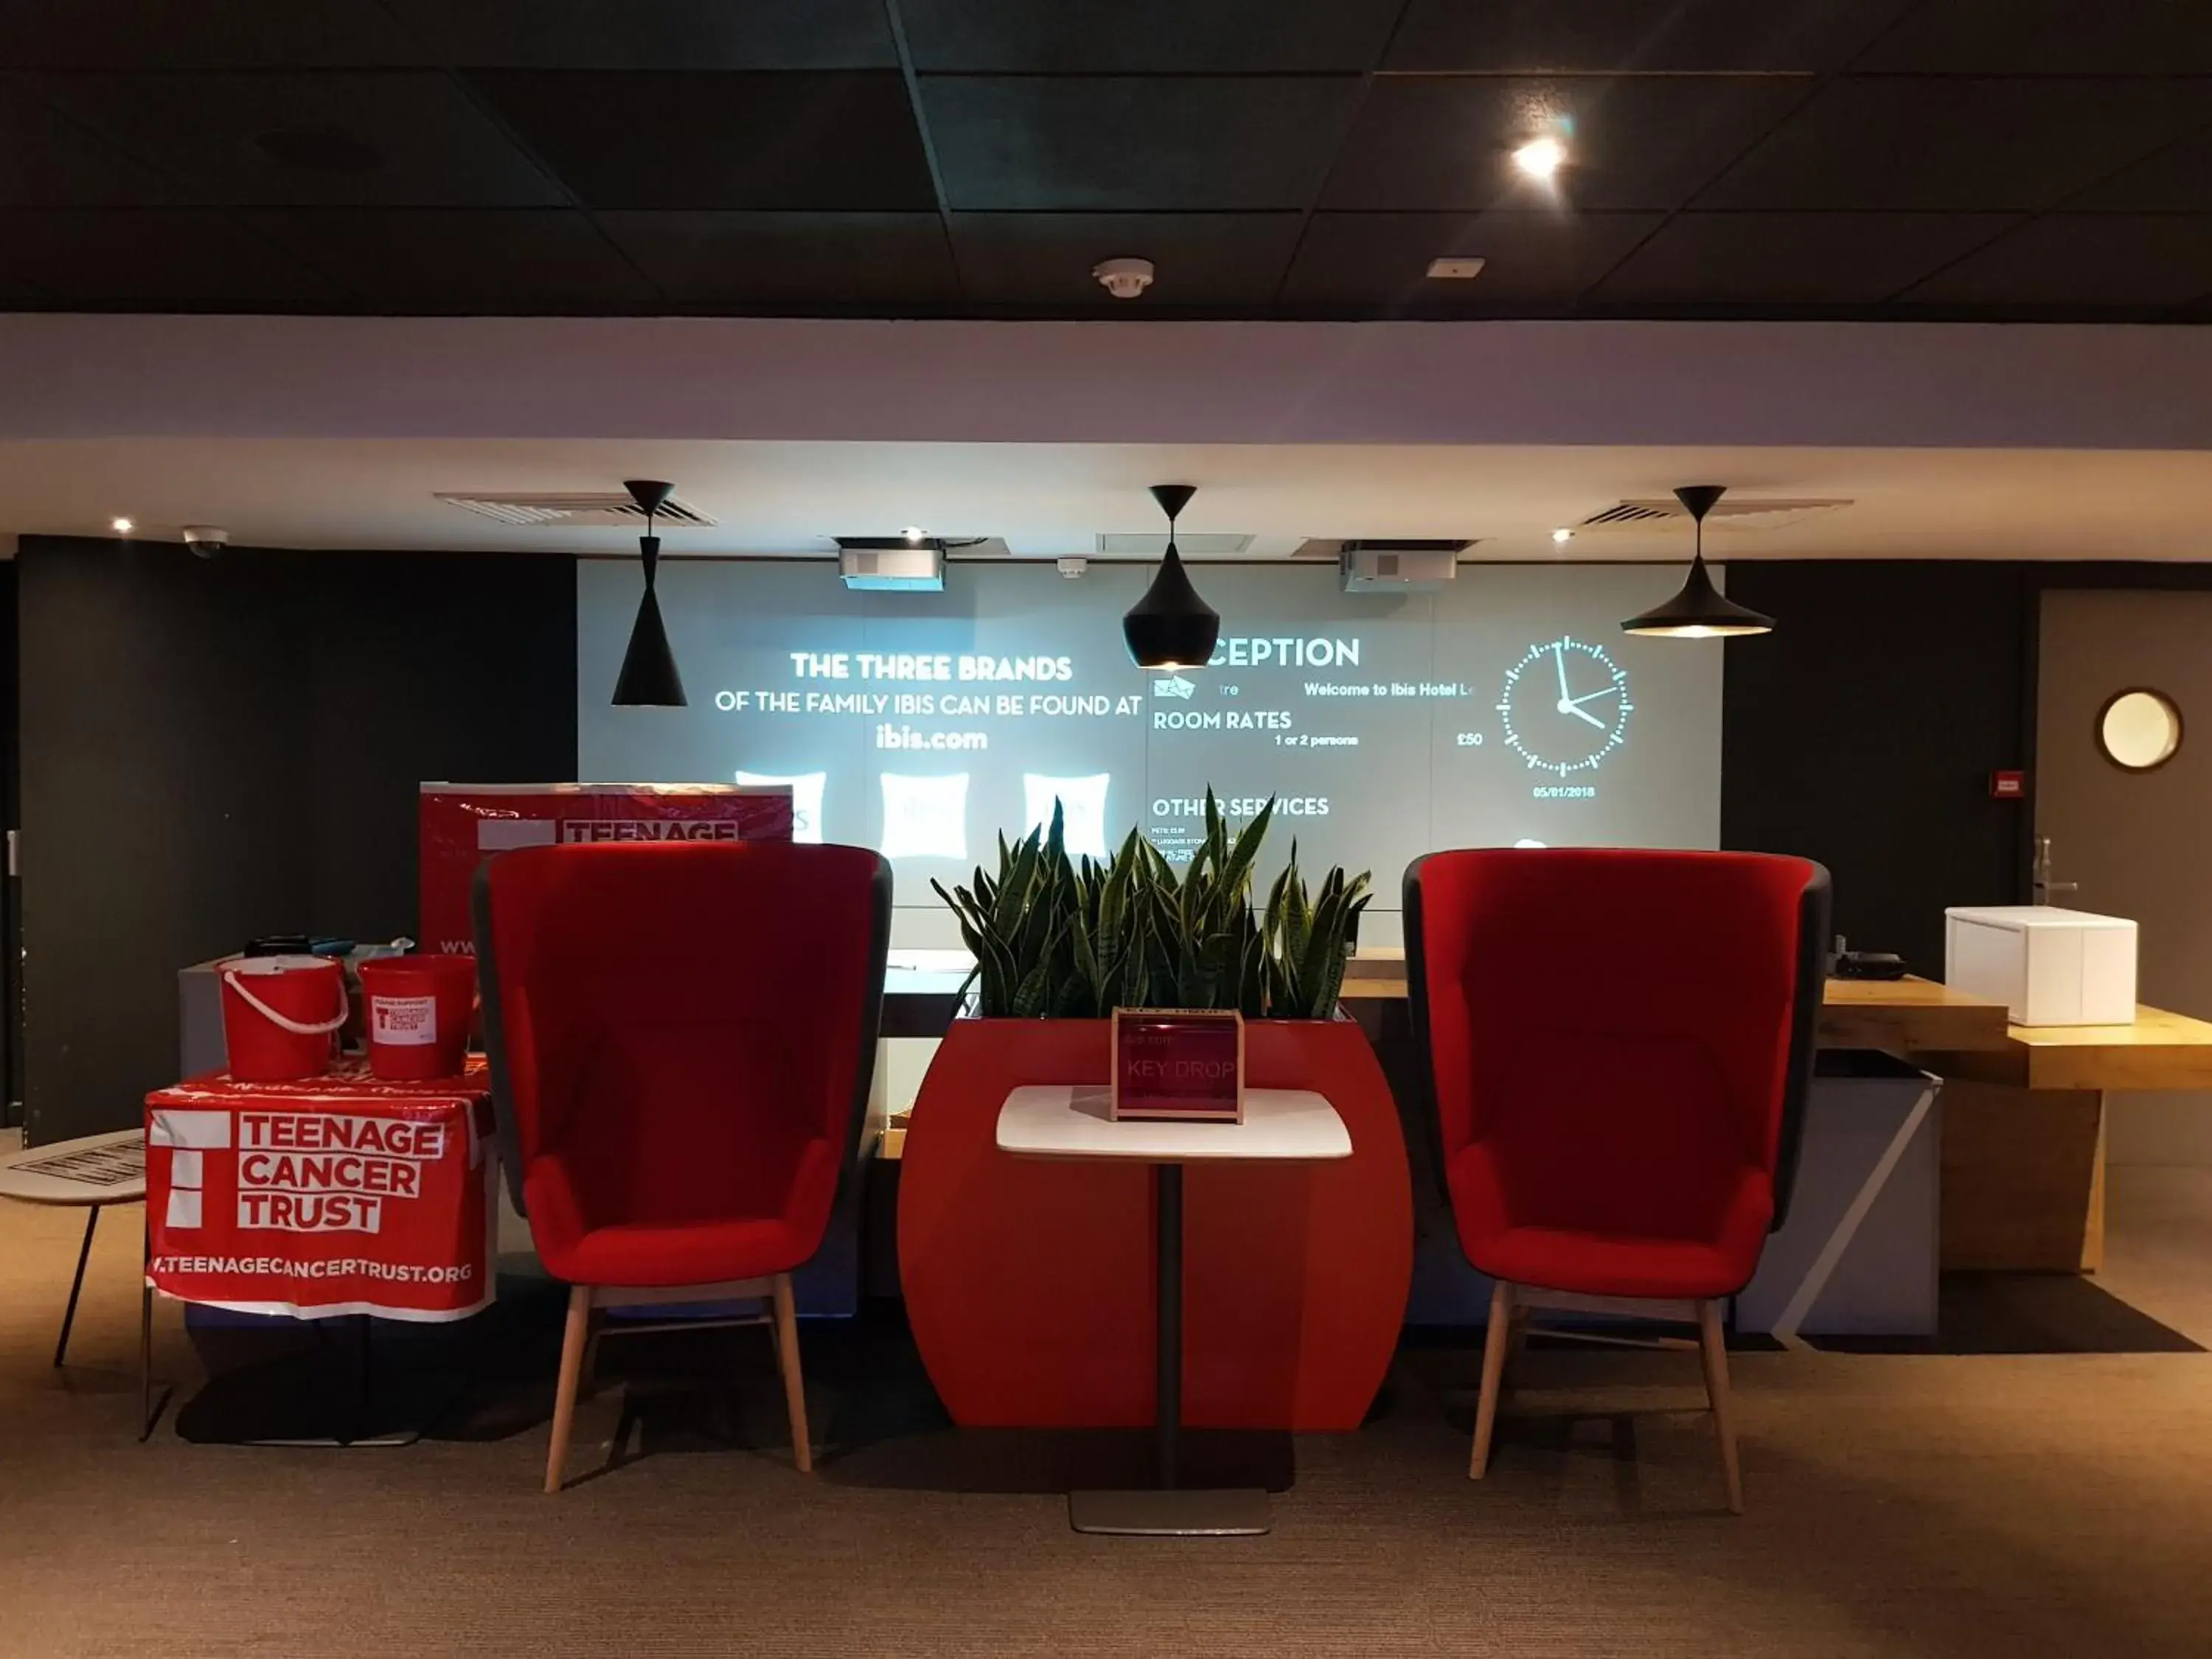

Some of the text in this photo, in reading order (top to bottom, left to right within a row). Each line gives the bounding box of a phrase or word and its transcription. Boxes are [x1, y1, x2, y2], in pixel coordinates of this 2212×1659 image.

[790, 653, 1073, 682] THE THREE BRANDS
[1304, 682, 1369, 697] Welcome
[1373, 684, 1388, 696] to
[1419, 682, 1457, 696] Hotel
[715, 691, 1143, 716] OF THE FAMILY IBIS CAN BE FOUND AT
[1154, 711, 1293, 730] ROOM RATES
[877, 723, 987, 749] ibis.com
[1275, 734, 1359, 748] 1 or 2 persons
[1457, 733, 1484, 745] £50
[1127, 1060, 1235, 1079] KEY DROP
[243, 1115, 440, 1156] TEENAGE
[241, 1154, 415, 1194] CANCER
[241, 1194, 377, 1228] TRUST
